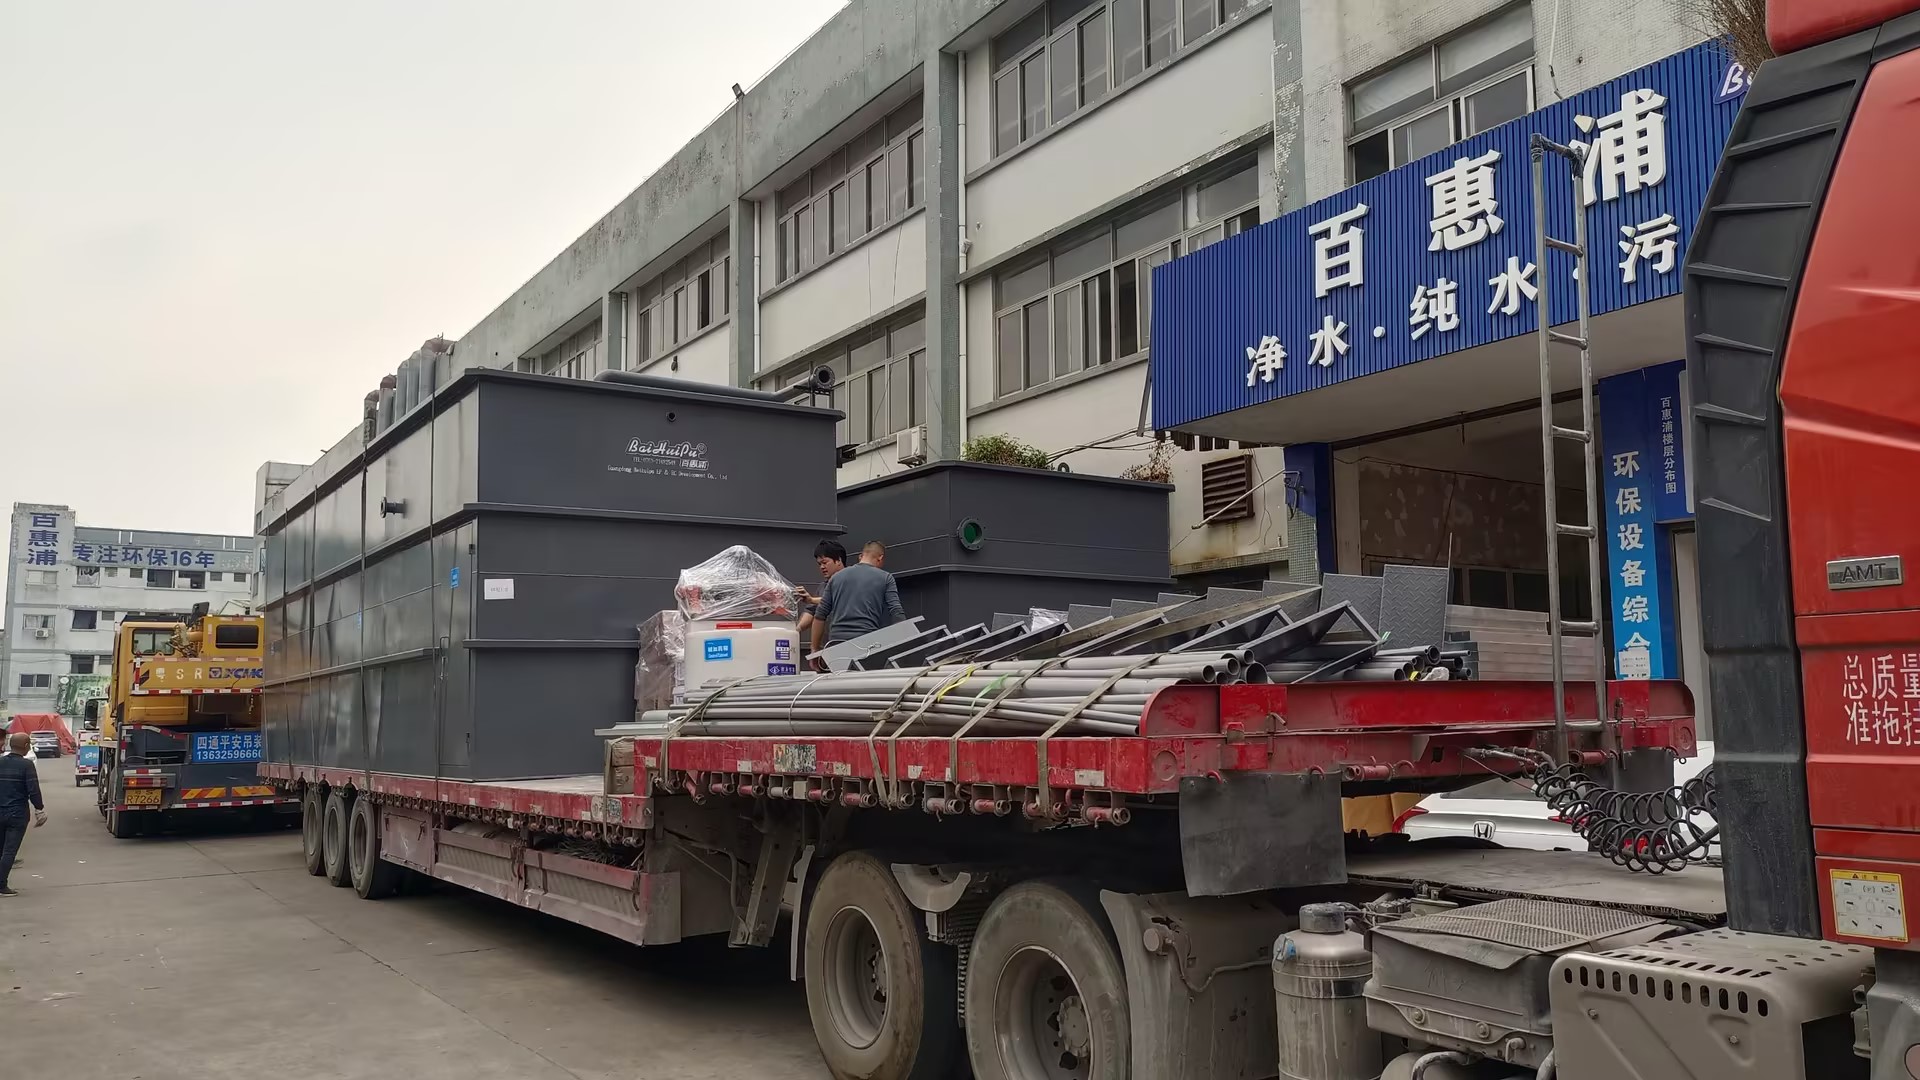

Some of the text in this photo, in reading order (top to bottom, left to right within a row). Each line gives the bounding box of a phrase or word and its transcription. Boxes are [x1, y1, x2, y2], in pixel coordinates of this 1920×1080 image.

[1308, 88, 1667, 299] 百惠浦
[1660, 396, 1677, 494] 百惠浦楼层分布图
[27, 512, 61, 566] 百惠浦
[72, 543, 215, 568] 专注环保16年
[1842, 562, 1887, 582] AMT
[1843, 653, 1920, 700] 总质量
[197, 735, 262, 750] 四通平安吊装
[127, 795, 160, 804] R7266
